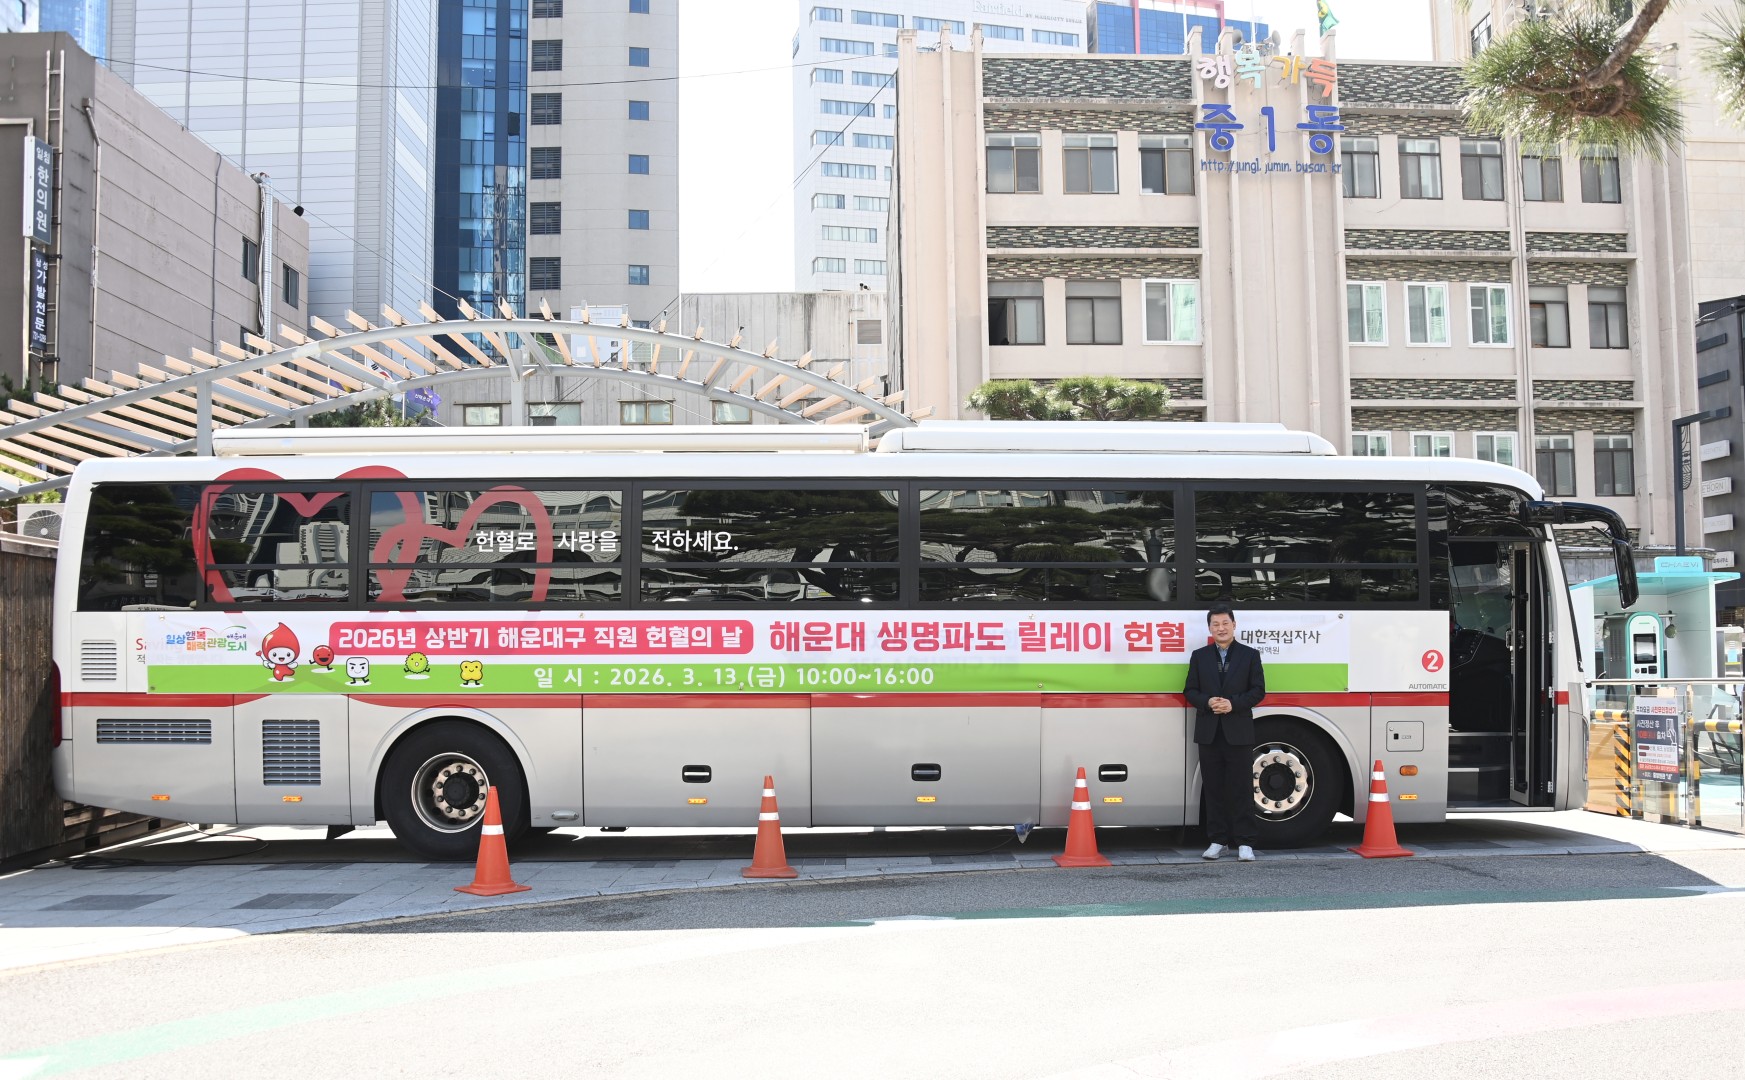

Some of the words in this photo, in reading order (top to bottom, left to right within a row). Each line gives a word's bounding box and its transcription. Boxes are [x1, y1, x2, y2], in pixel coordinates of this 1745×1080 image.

[36, 165, 50, 233] 한의원
[475, 530, 535, 552] 헌혈로
[557, 530, 619, 552] 사랑을
[651, 530, 739, 552] 전하세요.
[339, 628, 416, 649] 2026년
[425, 627, 489, 649] 상반기
[498, 627, 586, 649] 해운대구
[594, 627, 638, 649] 직원
[646, 627, 713, 649] 헌혈의
[721, 627, 743, 648] 날
[769, 621, 866, 652] 해운대
[876, 621, 1006, 652] 생명파도
[1018, 621, 1112, 653] 릴레이
[1123, 621, 1186, 653] 헌혈
[1240, 629, 1322, 644] 대한적십자사
[1426, 652, 1439, 670] 2
[534, 667, 553, 688] 일
[564, 667, 584, 687] 시
[610, 668, 672, 686] 2026.
[683, 668, 703, 686] 3.
[796, 667, 935, 685] 10:00~16:00
